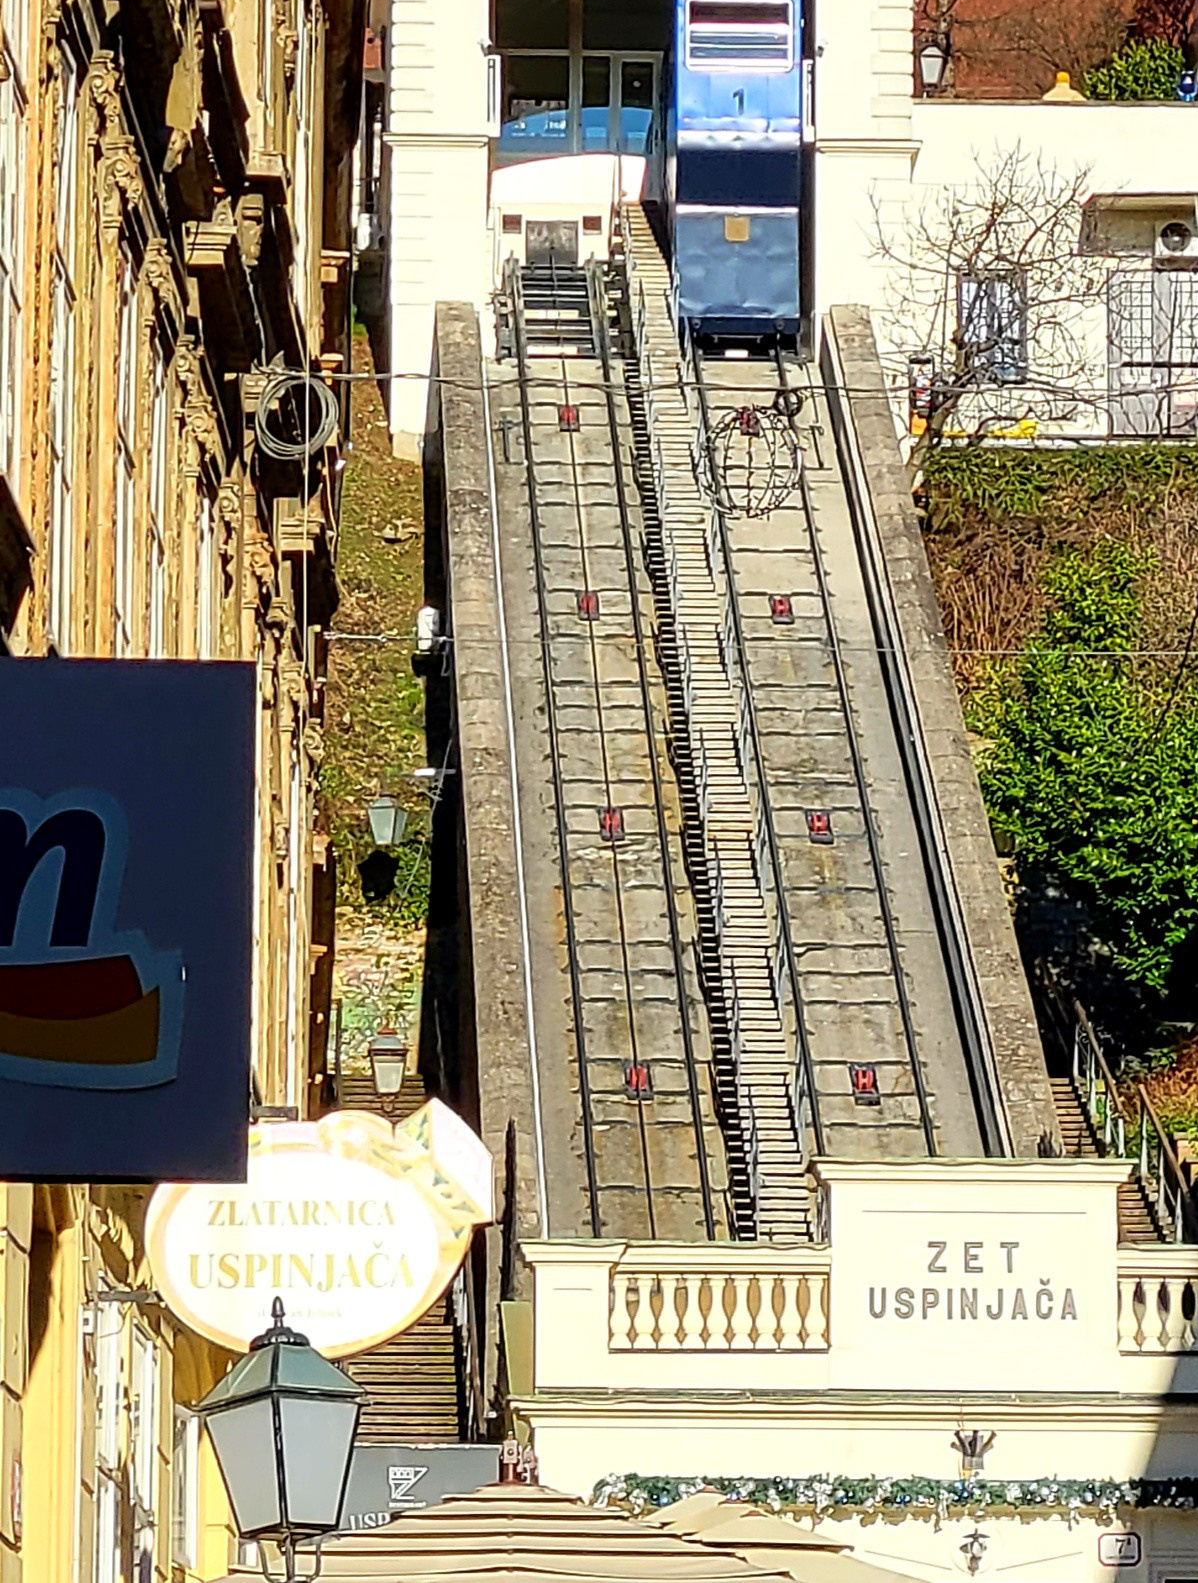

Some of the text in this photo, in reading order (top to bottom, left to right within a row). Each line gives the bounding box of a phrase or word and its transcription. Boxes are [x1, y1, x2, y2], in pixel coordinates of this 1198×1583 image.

[732, 88, 745, 116] 1
[207, 1200, 395, 1227] ZLATARNICA
[188, 1241, 415, 1293] USPINJAČA
[927, 1241, 1020, 1273] ZET
[868, 1277, 1078, 1321] USPINJAČA
